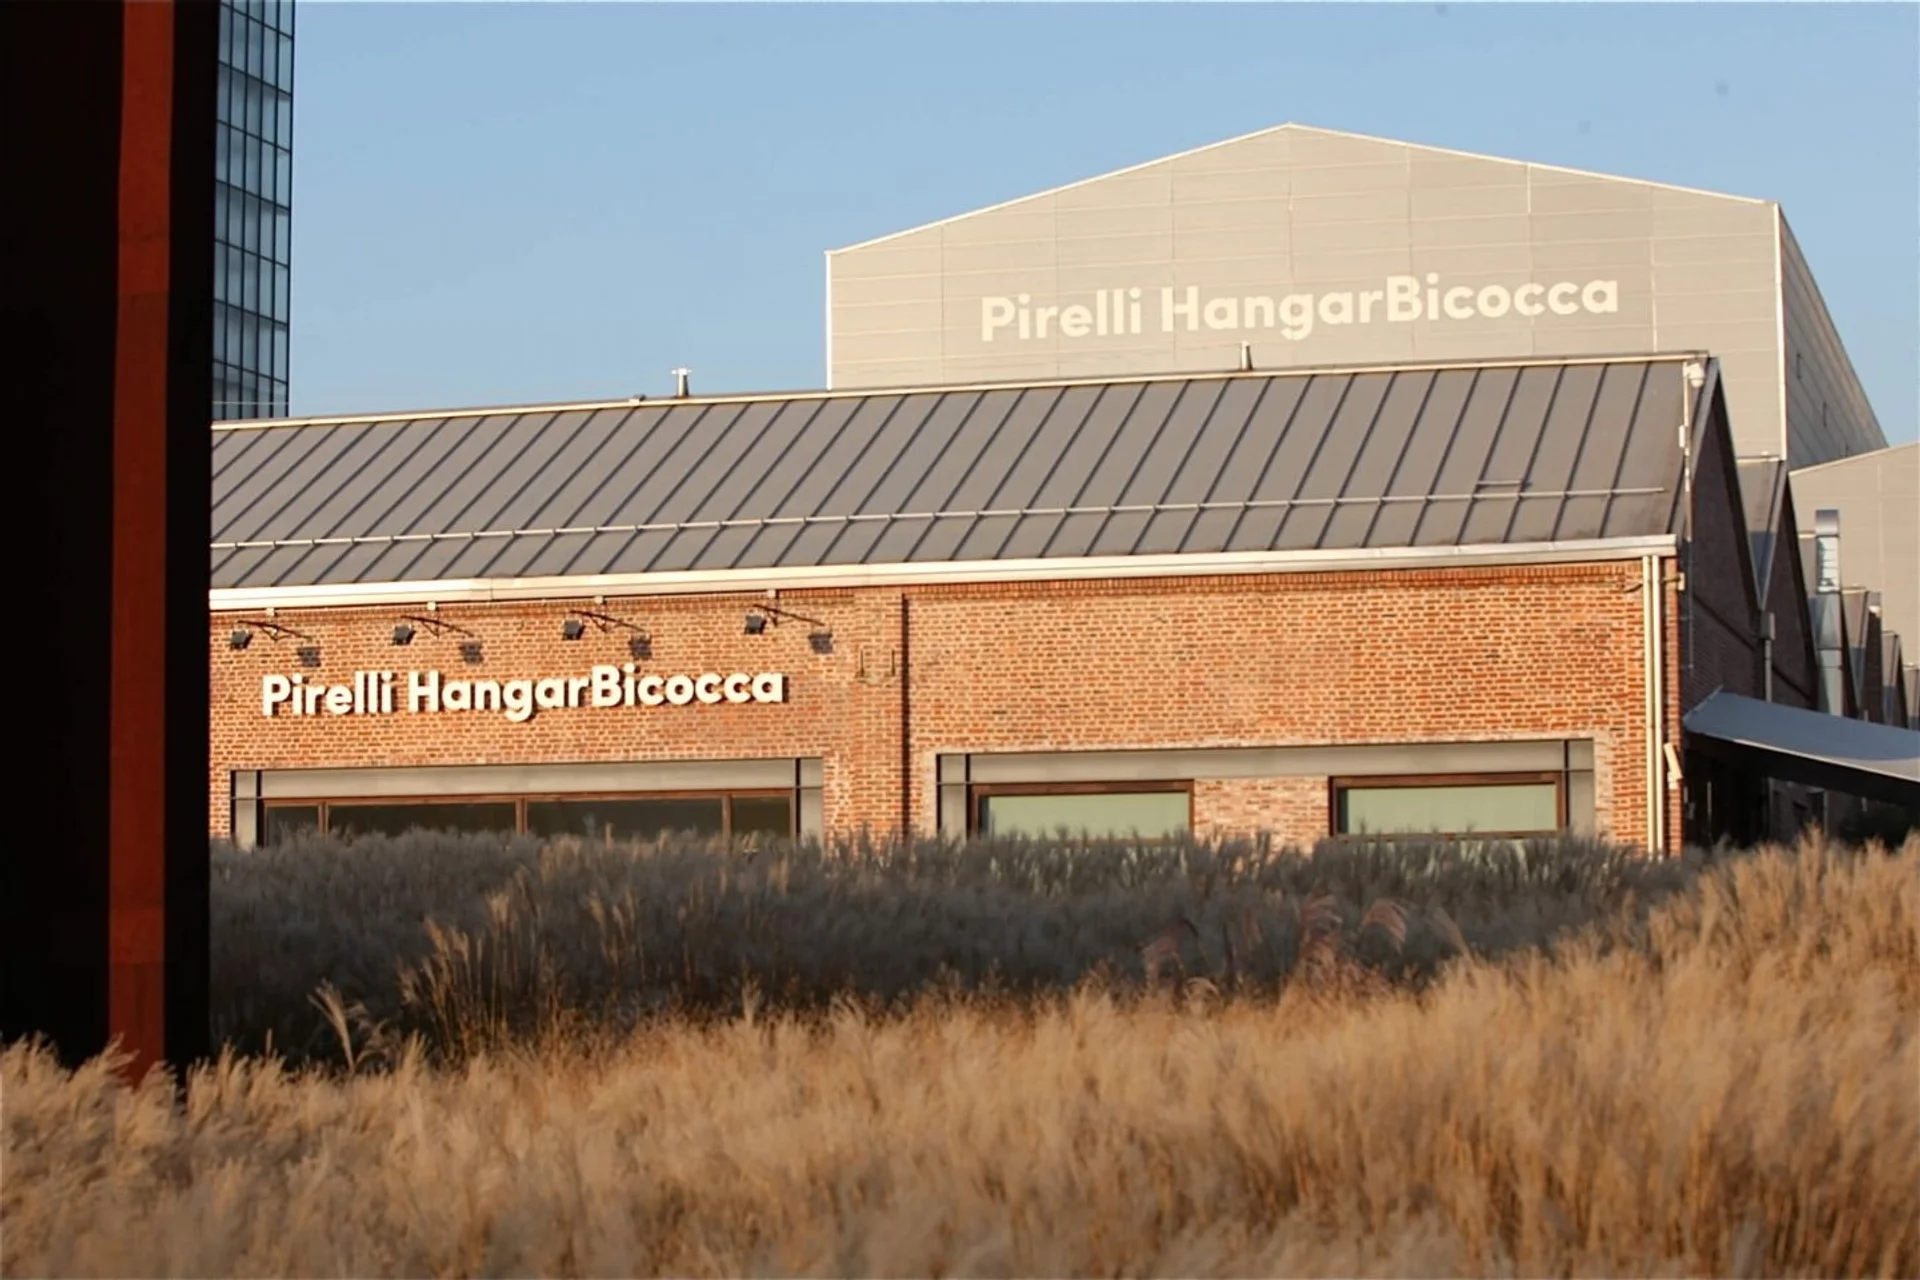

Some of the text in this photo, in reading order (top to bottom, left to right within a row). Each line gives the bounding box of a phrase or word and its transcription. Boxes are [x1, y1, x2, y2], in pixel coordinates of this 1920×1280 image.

[981, 272, 1619, 342] Pirelli HangarBicocca
[262, 663, 784, 722] Pirelli HangarBicocca
